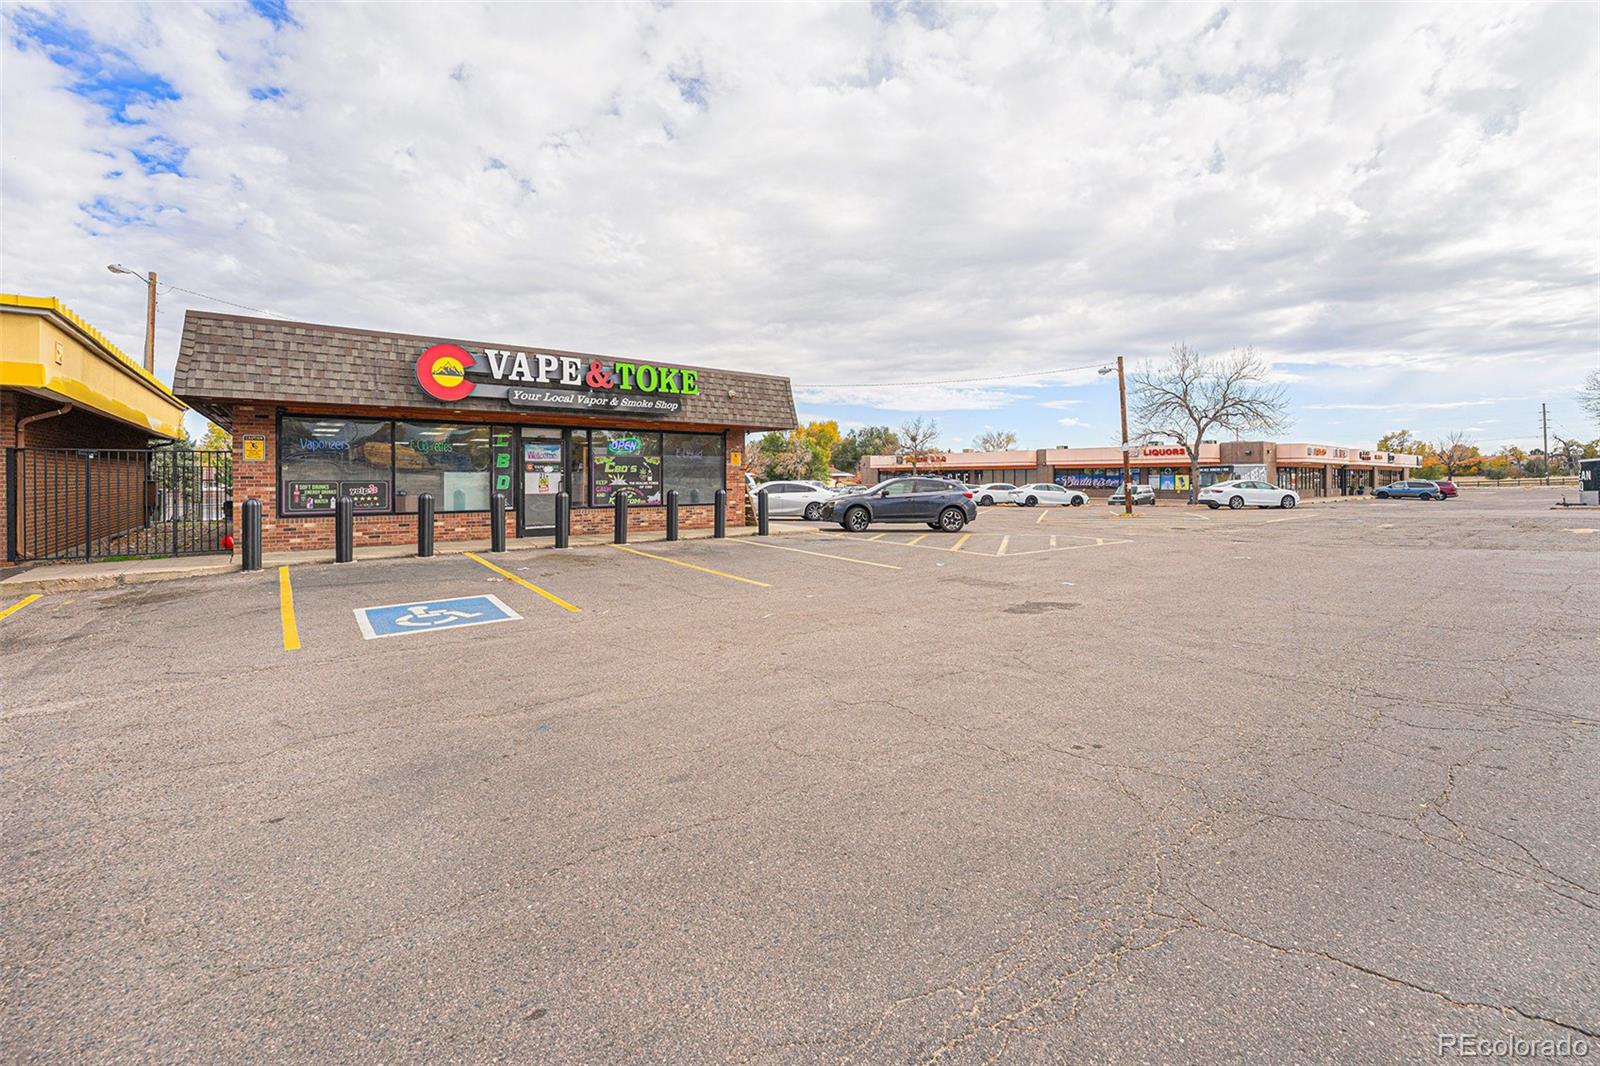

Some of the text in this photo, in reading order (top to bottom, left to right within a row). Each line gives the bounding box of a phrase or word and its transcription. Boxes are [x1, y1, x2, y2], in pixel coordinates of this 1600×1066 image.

[484, 349, 700, 396] VAPE & TOKE
[513, 391, 679, 411] Your Local Vapor & Smoke Shop
[611, 439, 638, 451] OPEN
[1143, 447, 1185, 457] LIQUORS
